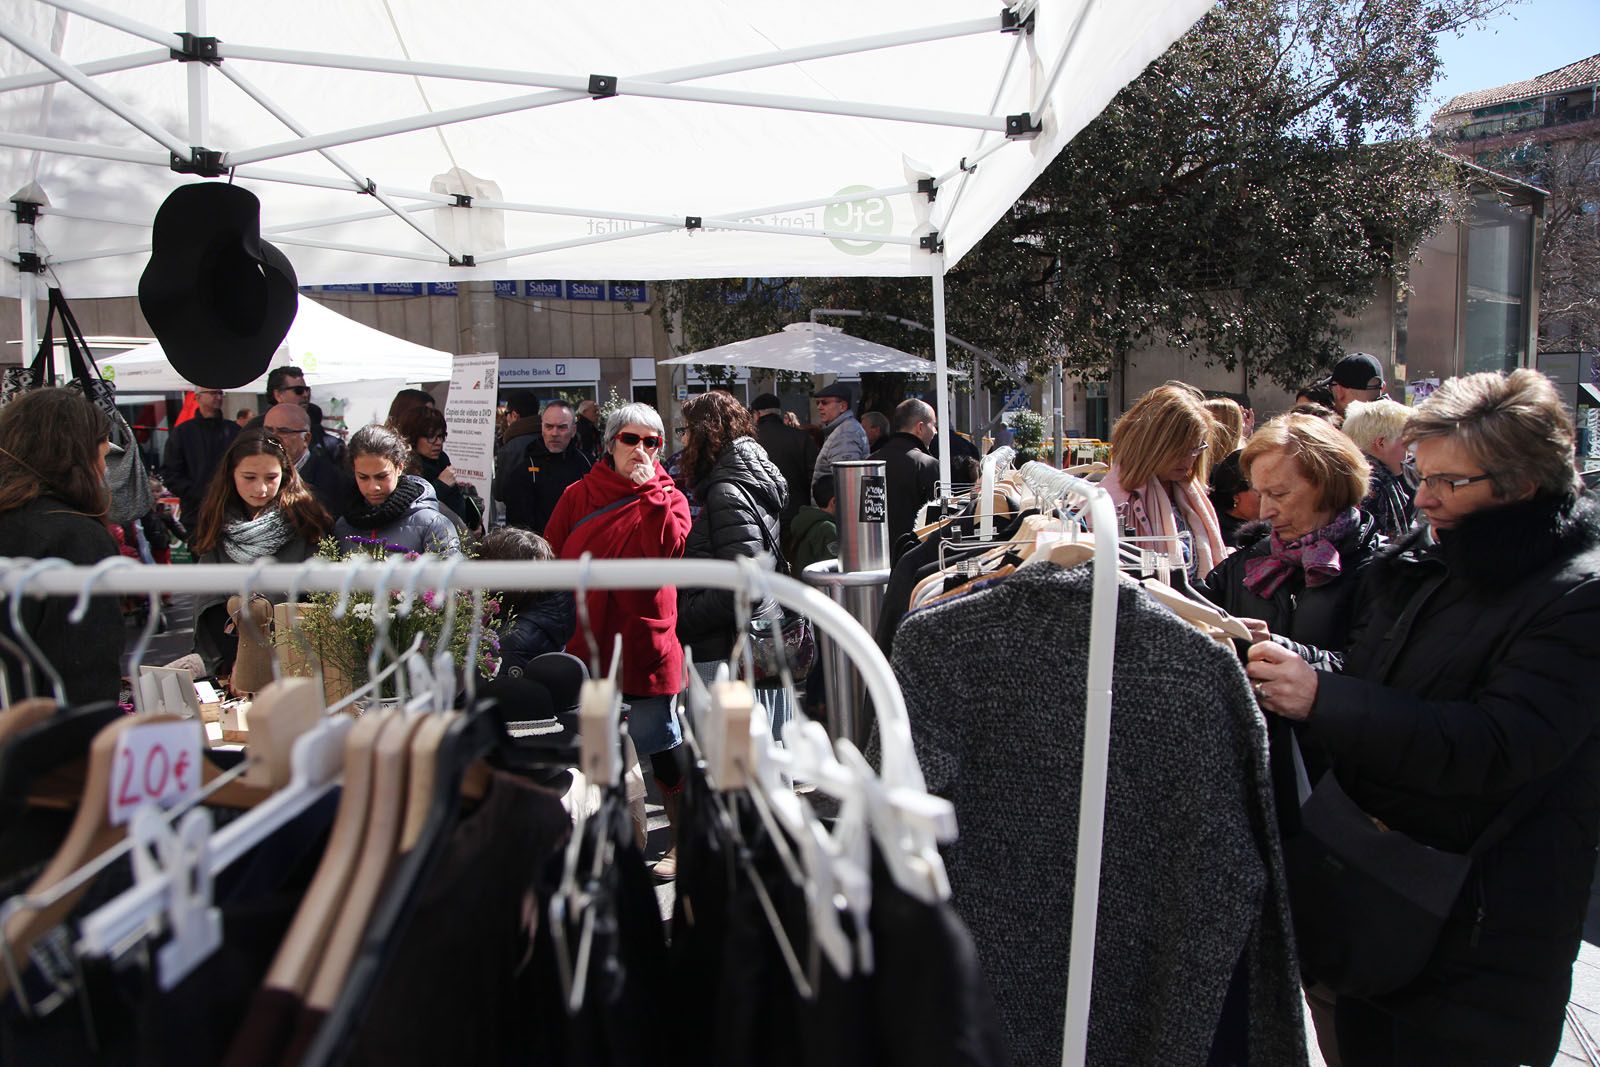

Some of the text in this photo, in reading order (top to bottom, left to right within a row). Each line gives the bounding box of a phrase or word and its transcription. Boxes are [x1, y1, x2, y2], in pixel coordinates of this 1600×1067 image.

[495, 281, 511, 291] bat
[529, 281, 557, 293] Sabat
[572, 283, 599, 294] Sabat
[499, 367, 551, 376] eutsche Bank
[117, 743, 190, 807] 20€
